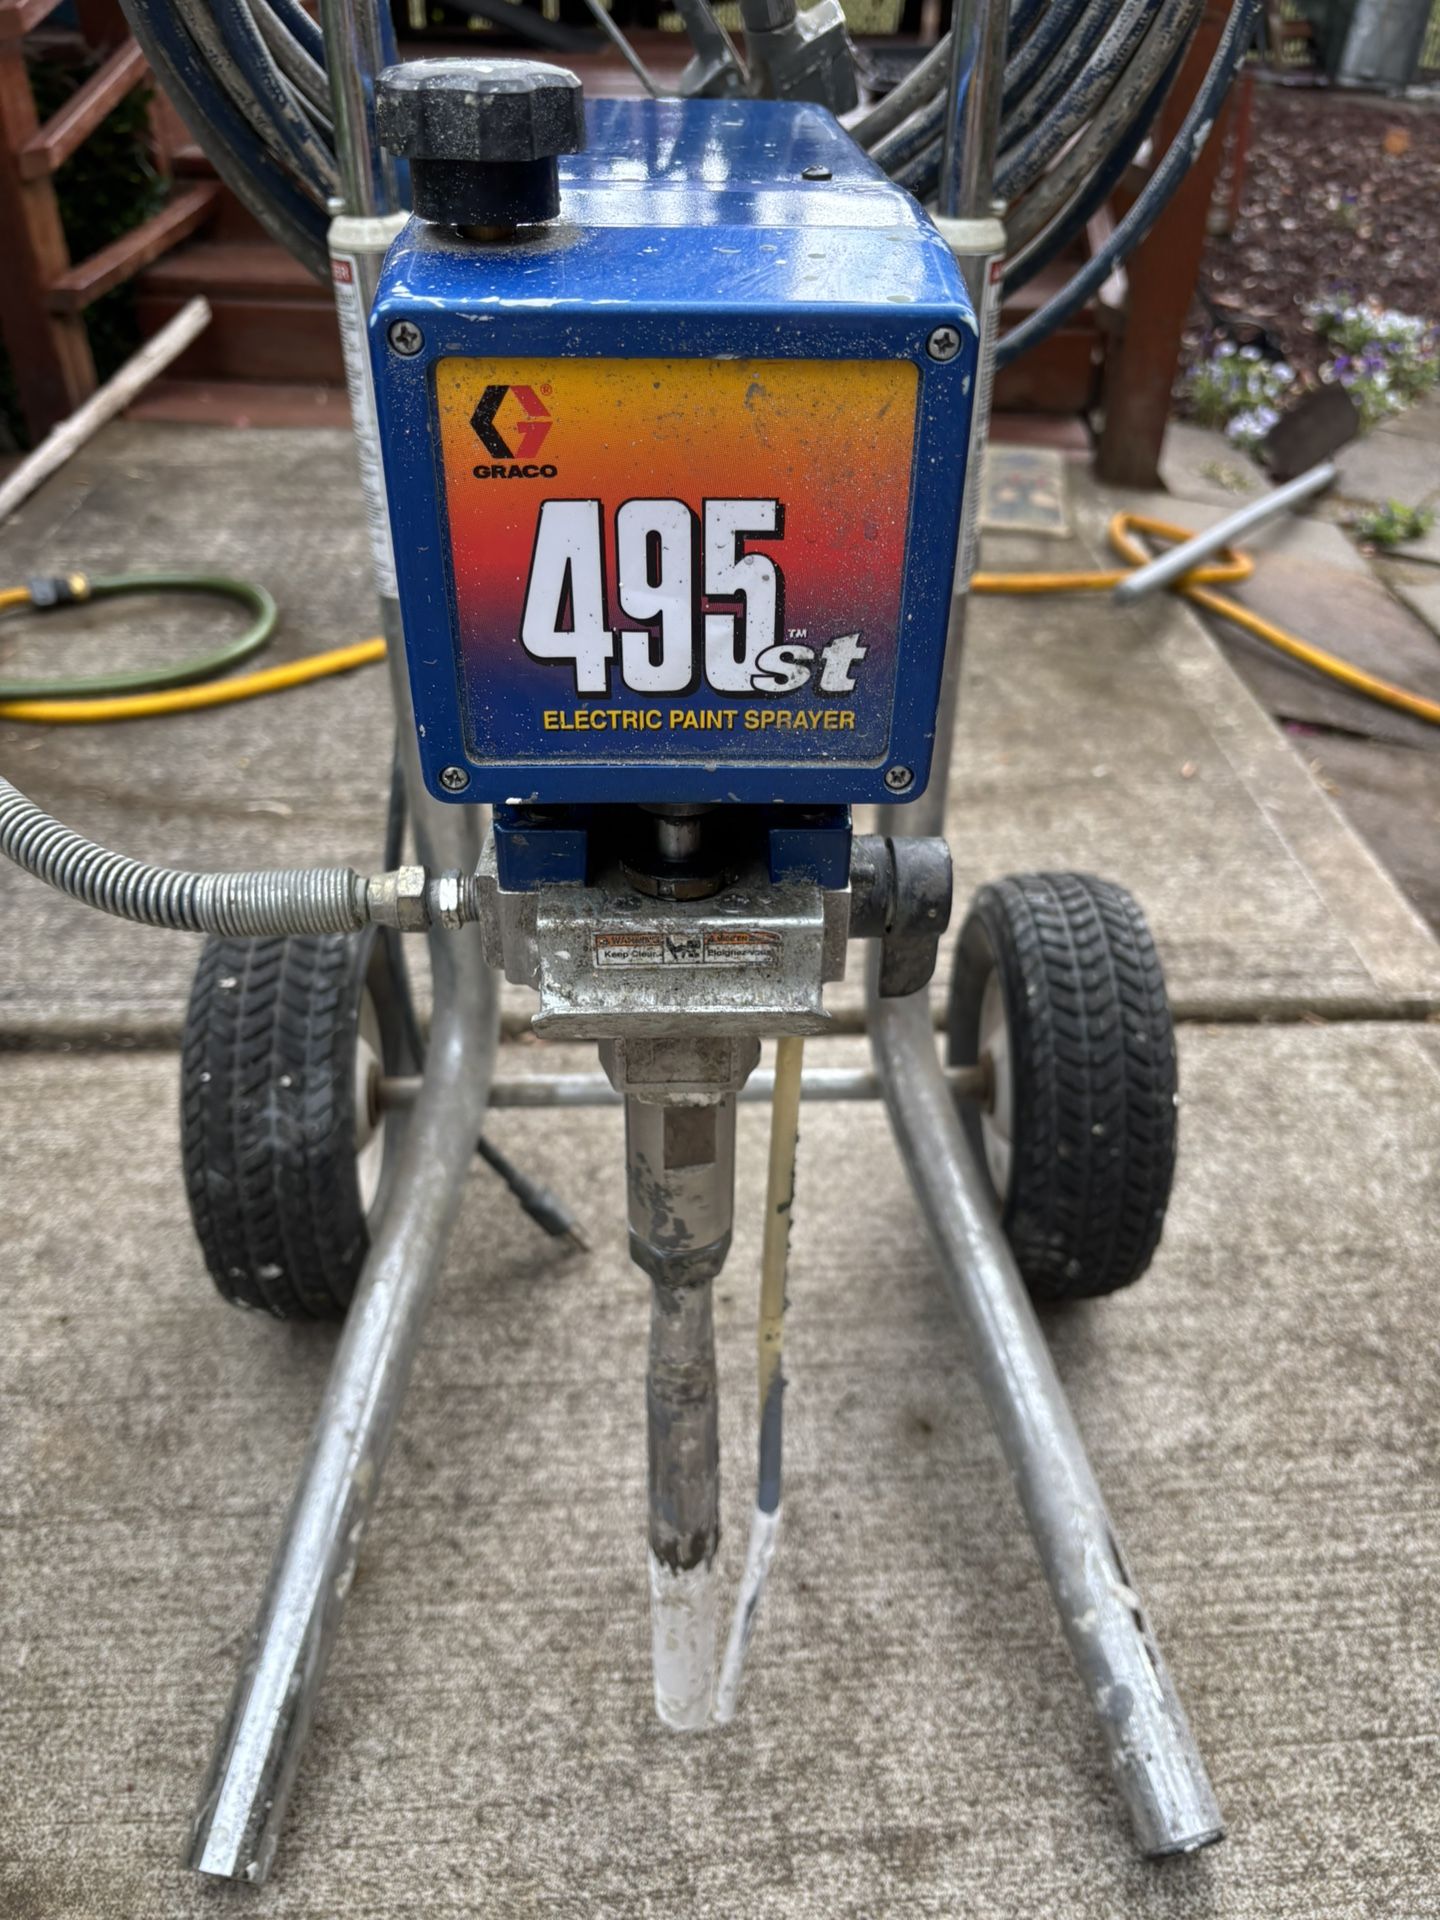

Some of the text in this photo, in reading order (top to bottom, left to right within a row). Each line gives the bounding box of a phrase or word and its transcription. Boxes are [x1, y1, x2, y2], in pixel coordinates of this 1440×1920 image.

[473, 464, 558, 479] GRACO
[543, 709, 856, 730] ELECTRIC PAINT SPRAYER
[604, 950, 629, 958] Keep
